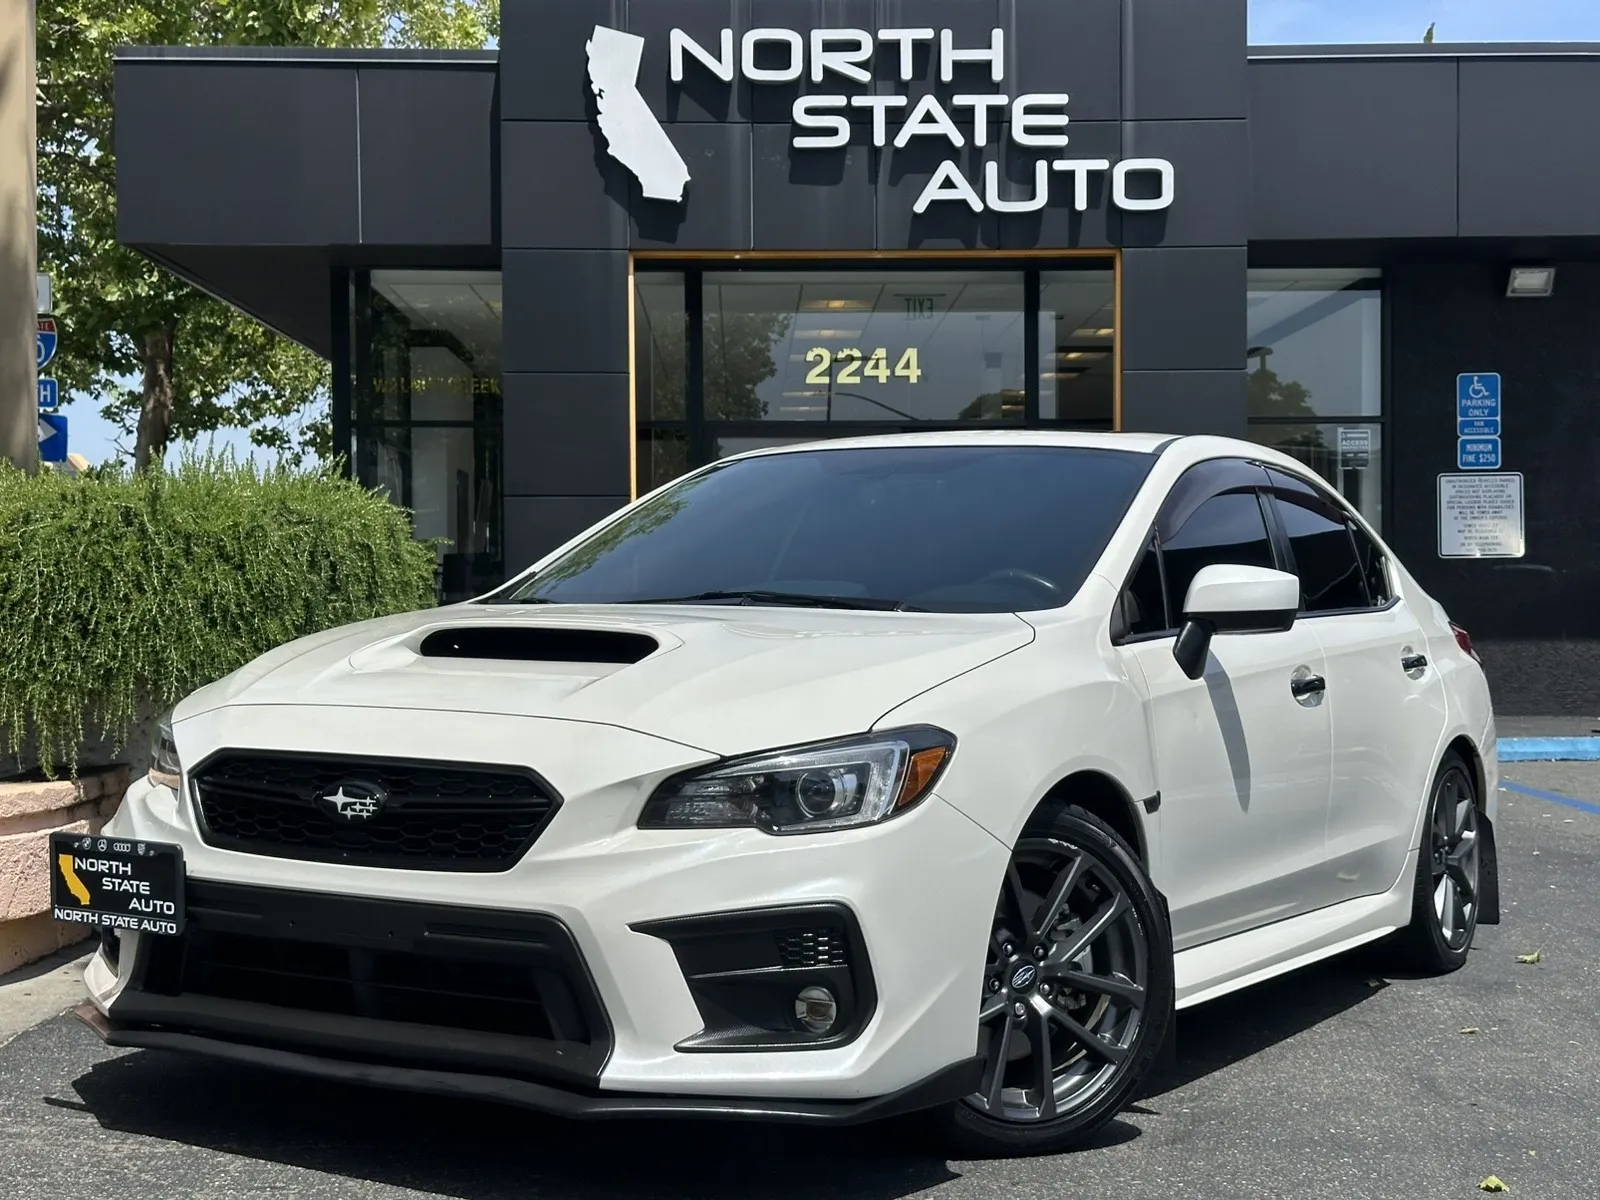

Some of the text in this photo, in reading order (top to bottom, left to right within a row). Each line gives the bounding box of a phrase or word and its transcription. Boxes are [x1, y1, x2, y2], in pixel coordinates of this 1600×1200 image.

[670, 28, 1004, 83] NORTH
[792, 93, 1069, 148] STATE
[913, 158, 1175, 213] AUTO
[805, 346, 922, 384] 2244
[1461, 398, 1497, 407] PARKING
[1467, 408, 1489, 417] ONLY
[1462, 453, 1497, 463] FINE $250
[74, 857, 132, 875] NORTH
[102, 877, 151, 895] STATE
[128, 898, 175, 915] AUTO
[54, 908, 177, 934] NORTH STATE AUTO
